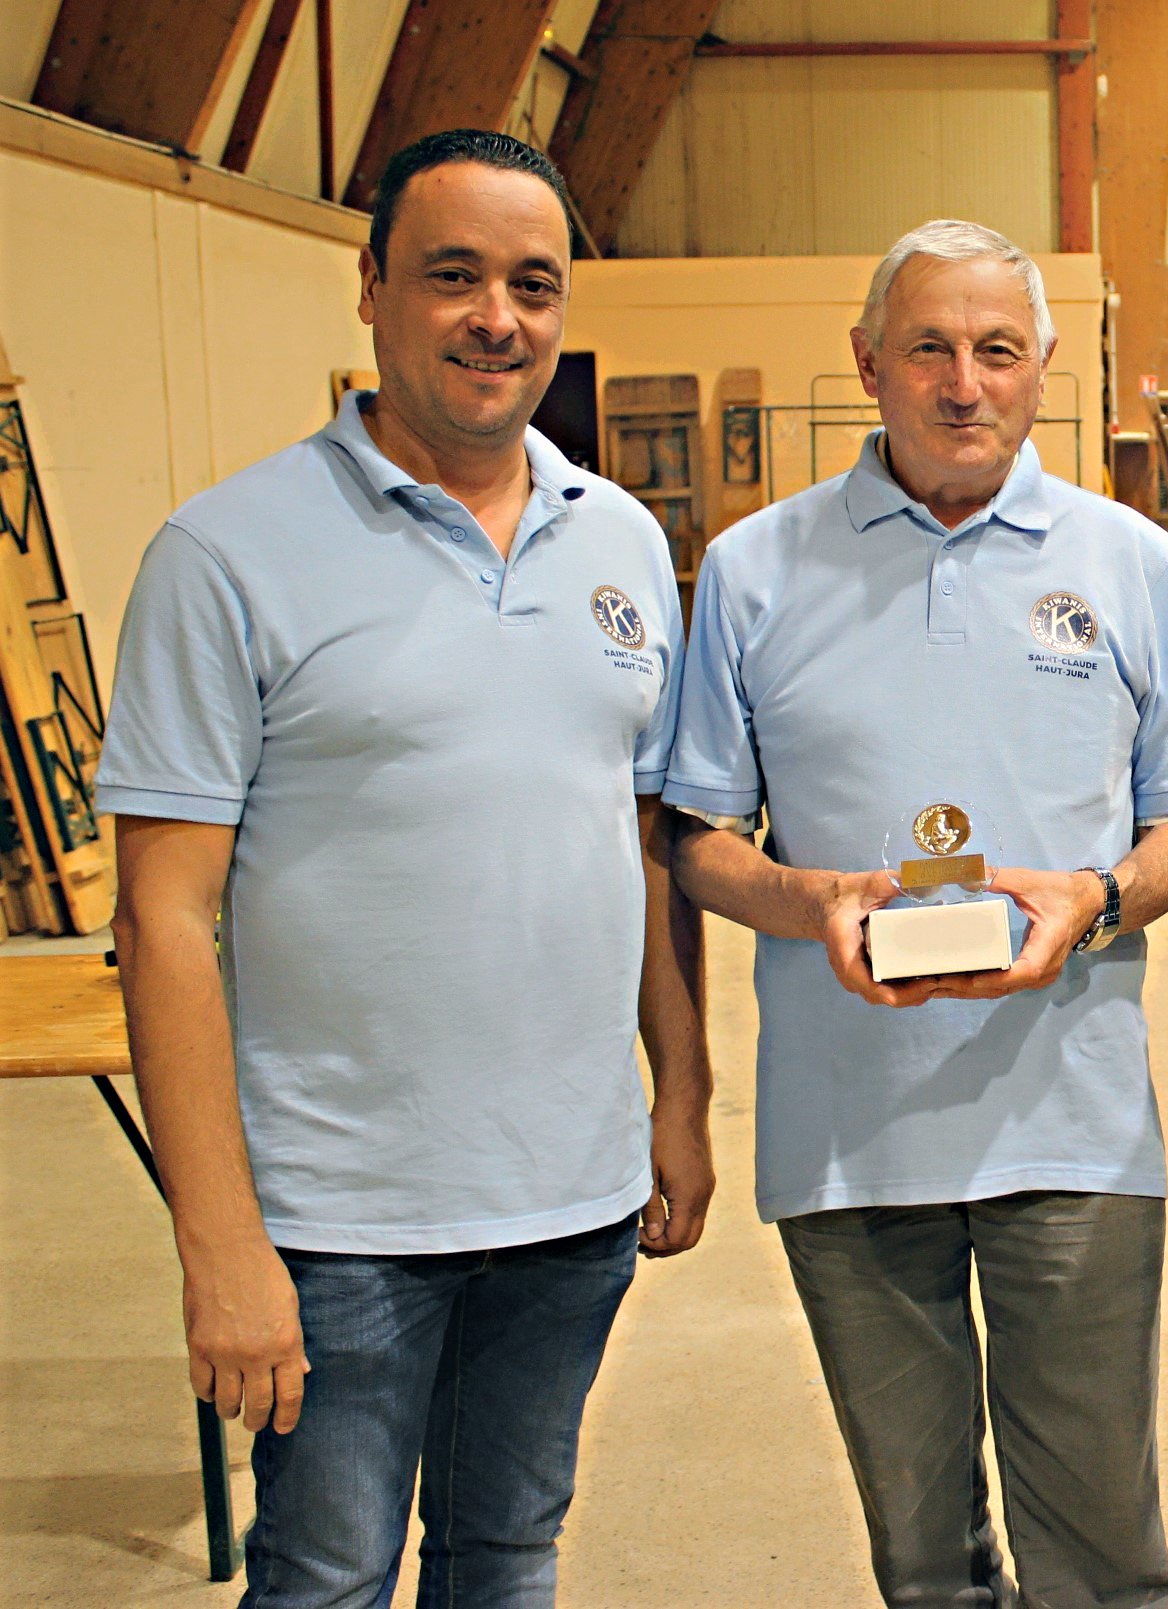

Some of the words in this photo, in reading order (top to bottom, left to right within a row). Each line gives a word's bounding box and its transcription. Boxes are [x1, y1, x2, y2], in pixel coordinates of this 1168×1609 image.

[597, 590, 632, 609] KIWANIS
[1042, 597, 1087, 614] KIWANIS
[604, 599, 636, 637] K
[1050, 606, 1079, 642] K
[1034, 616, 1092, 651] INTERNATIONAL
[603, 649, 655, 667] SAINT-CLAUDE
[1027, 654, 1098, 671] SAINT-CLAUDE
[613, 660, 654, 677] HAUT-JURA
[1035, 664, 1090, 680] HAUT-JURA
